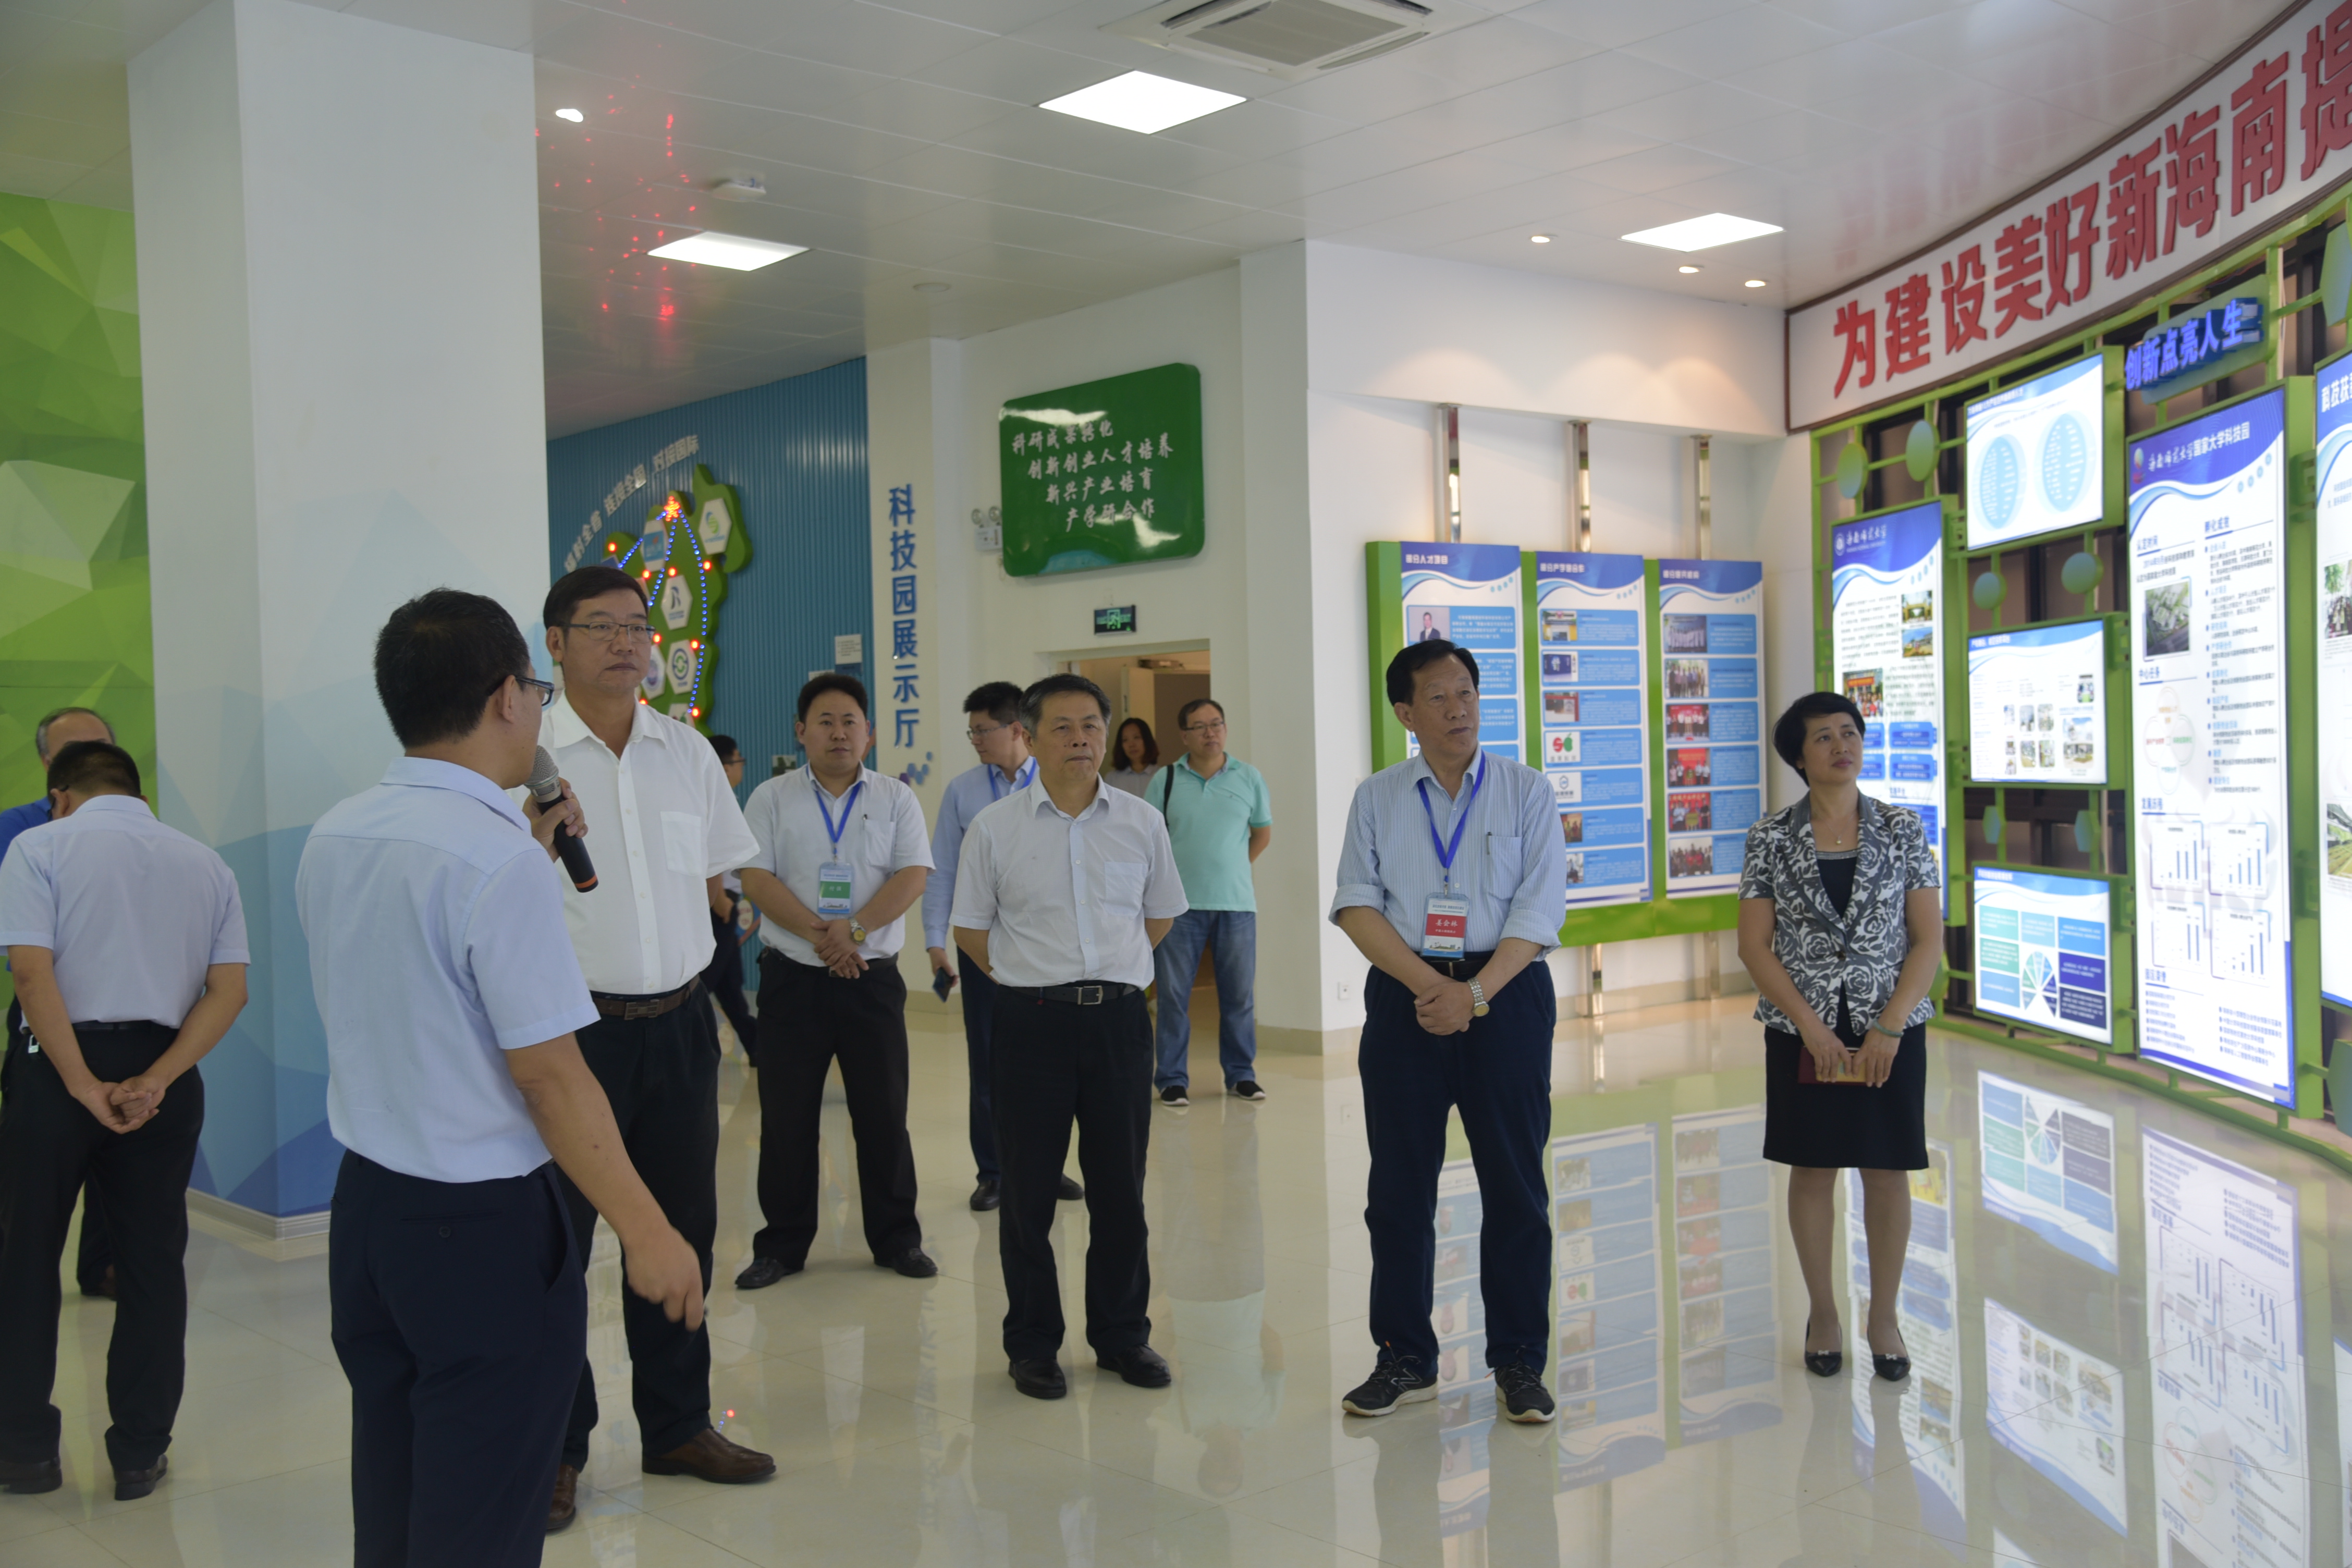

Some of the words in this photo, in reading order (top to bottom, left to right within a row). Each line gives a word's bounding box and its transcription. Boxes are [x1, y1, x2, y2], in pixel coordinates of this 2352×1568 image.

[2125, 299, 2242, 390] 创新点亮人生
[2321, 372, 2352, 413] 科技扶
[1012, 419, 1113, 456] 科研成果转化
[1028, 432, 1173, 480] 创新创业人才培养
[1045, 466, 1153, 505] 新兴产业培育
[1066, 498, 1155, 532] 产学研合作
[1405, 554, 1448, 565] 部分人才项目
[889, 484, 919, 749] 科技园展示厅
